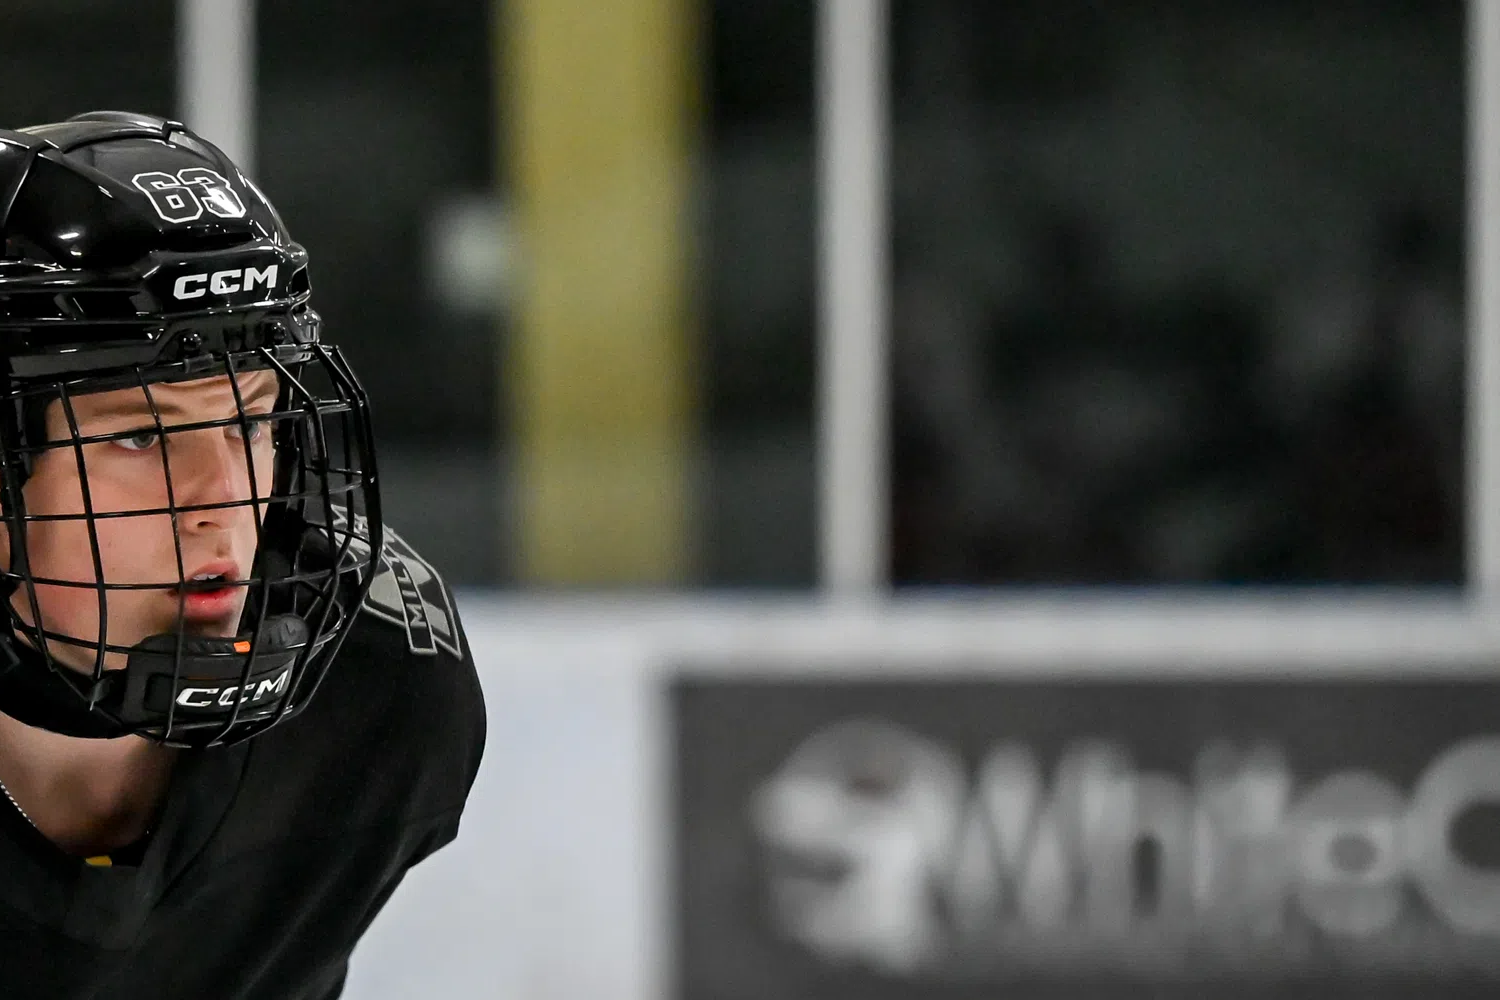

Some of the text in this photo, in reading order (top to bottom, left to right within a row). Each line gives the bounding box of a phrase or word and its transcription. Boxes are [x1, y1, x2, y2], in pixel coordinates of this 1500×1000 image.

[132, 167, 246, 223] 63
[173, 264, 279, 300] CCM
[176, 670, 288, 707] CCM
